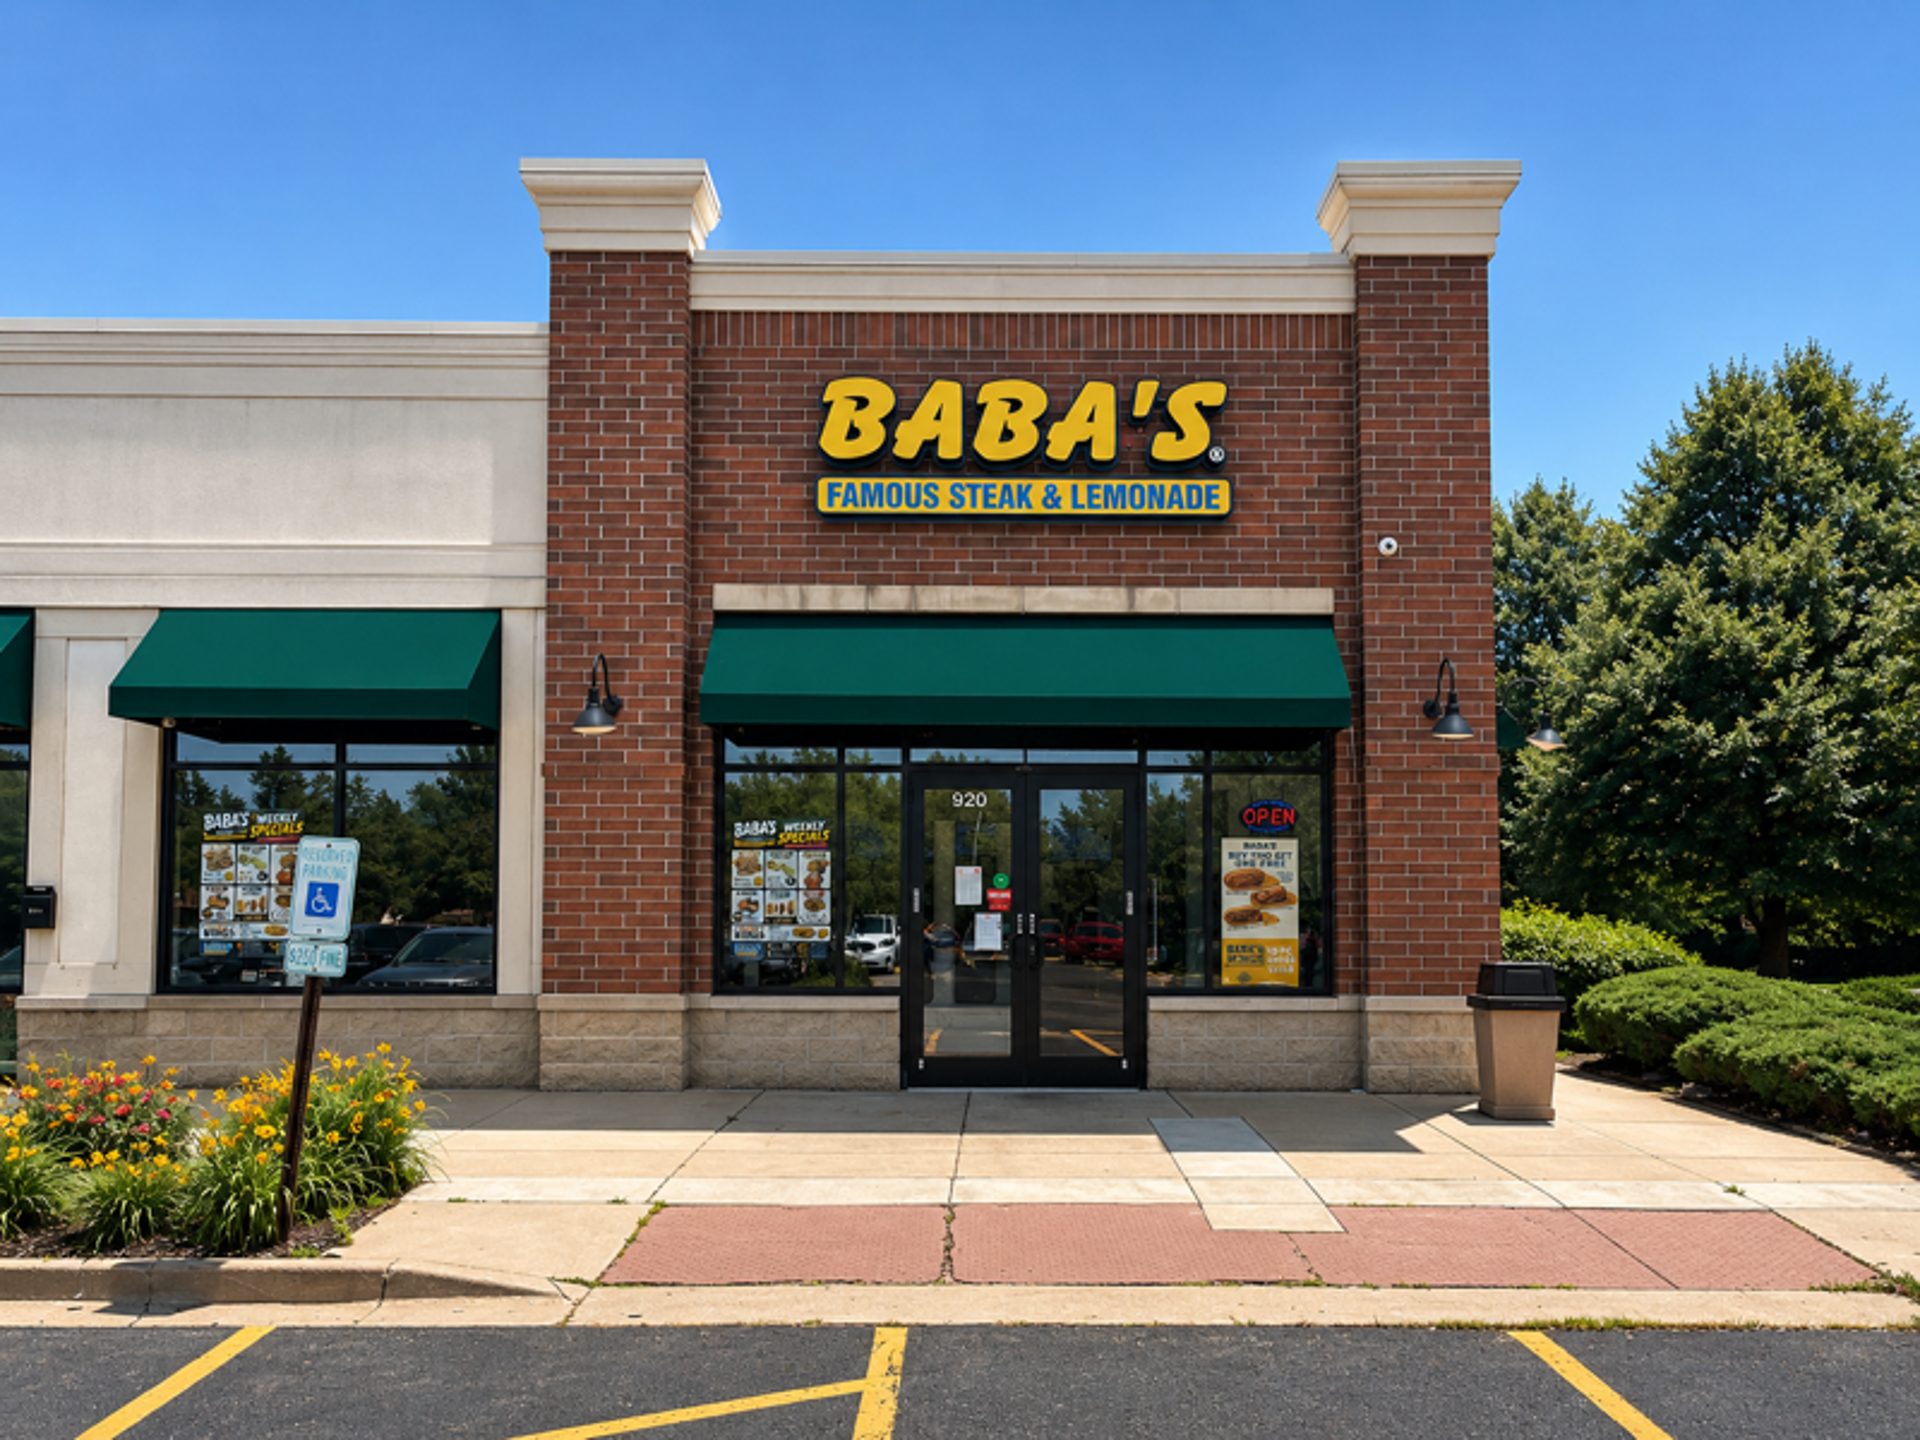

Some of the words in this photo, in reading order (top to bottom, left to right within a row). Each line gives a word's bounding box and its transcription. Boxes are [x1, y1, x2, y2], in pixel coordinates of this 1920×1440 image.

[818, 377, 1228, 462] BABA'S
[826, 481, 940, 510] FAMOUS
[949, 482, 1034, 510] STEAK
[1043, 482, 1063, 510] &
[1071, 483, 1221, 511] LEMONADE
[952, 791, 988, 808] 920
[1242, 807, 1296, 826] OPEN
